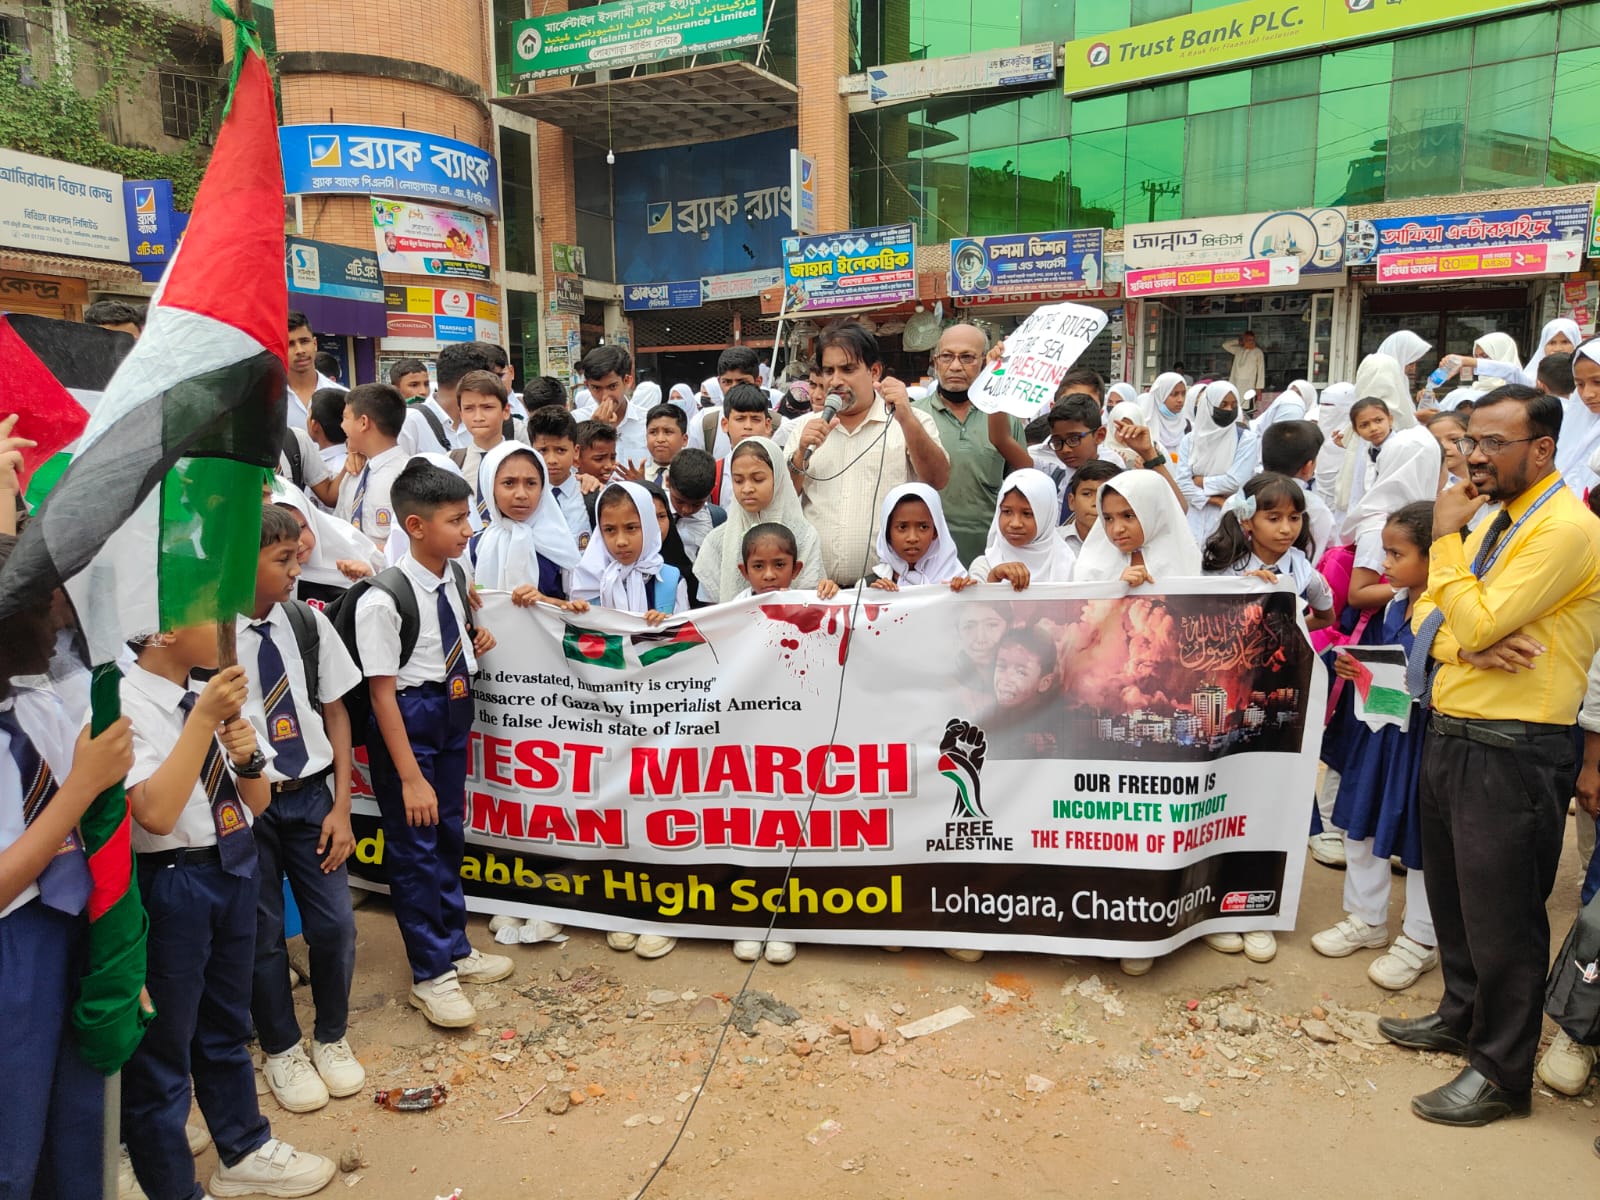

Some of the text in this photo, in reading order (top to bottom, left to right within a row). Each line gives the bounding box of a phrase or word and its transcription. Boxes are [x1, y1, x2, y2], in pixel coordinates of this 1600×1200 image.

[544, 8, 757, 54] Mercantile Islami Life Insurance Limited
[1119, 6, 1304, 62] Trust Bank PLC.
[1223, 39, 1259, 50] Financial
[348, 136, 491, 188] ব্র্যাক ব্যাংক
[0, 166, 56, 190] আমিরাবাদ
[89, 185, 113, 203] কেন্দ্র
[677, 194, 738, 234] ব্র্যাক
[744, 186, 792, 221] ব্যাং
[989, 242, 1025, 259] চশমা
[1029, 237, 1067, 257] ভিশন
[1133, 229, 1203, 252] জান্নাত
[790, 260, 833, 277] জাহান
[1057, 314, 1099, 343] RIVER
[1038, 338, 1064, 361] SEA
[1011, 379, 1049, 404] FREE
[482, 668, 492, 682] is
[495, 670, 574, 689] devastated,
[577, 677, 644, 694] humanity
[648, 677, 661, 691] is
[541, 693, 558, 707] of
[562, 694, 600, 712] Gaza
[603, 700, 624, 716] by
[629, 697, 722, 715] imperialist
[727, 695, 802, 712] America
[479, 708, 721, 737] the false Jewish state of Israel
[628, 742, 909, 797] MARCH
[1074, 772, 1216, 795] OUR FREEDOM IS
[465, 791, 889, 849] MAN CHAIN
[1053, 793, 1228, 823] INCOMPLETE WITHOUT
[945, 820, 994, 837] FREE
[1031, 814, 1248, 854] THE FREEDOM OF PALESTINE
[925, 837, 1014, 852] PALESTINE
[460, 852, 903, 916] abbar High School
[930, 884, 1217, 927] Lohagara, Chattogram.
